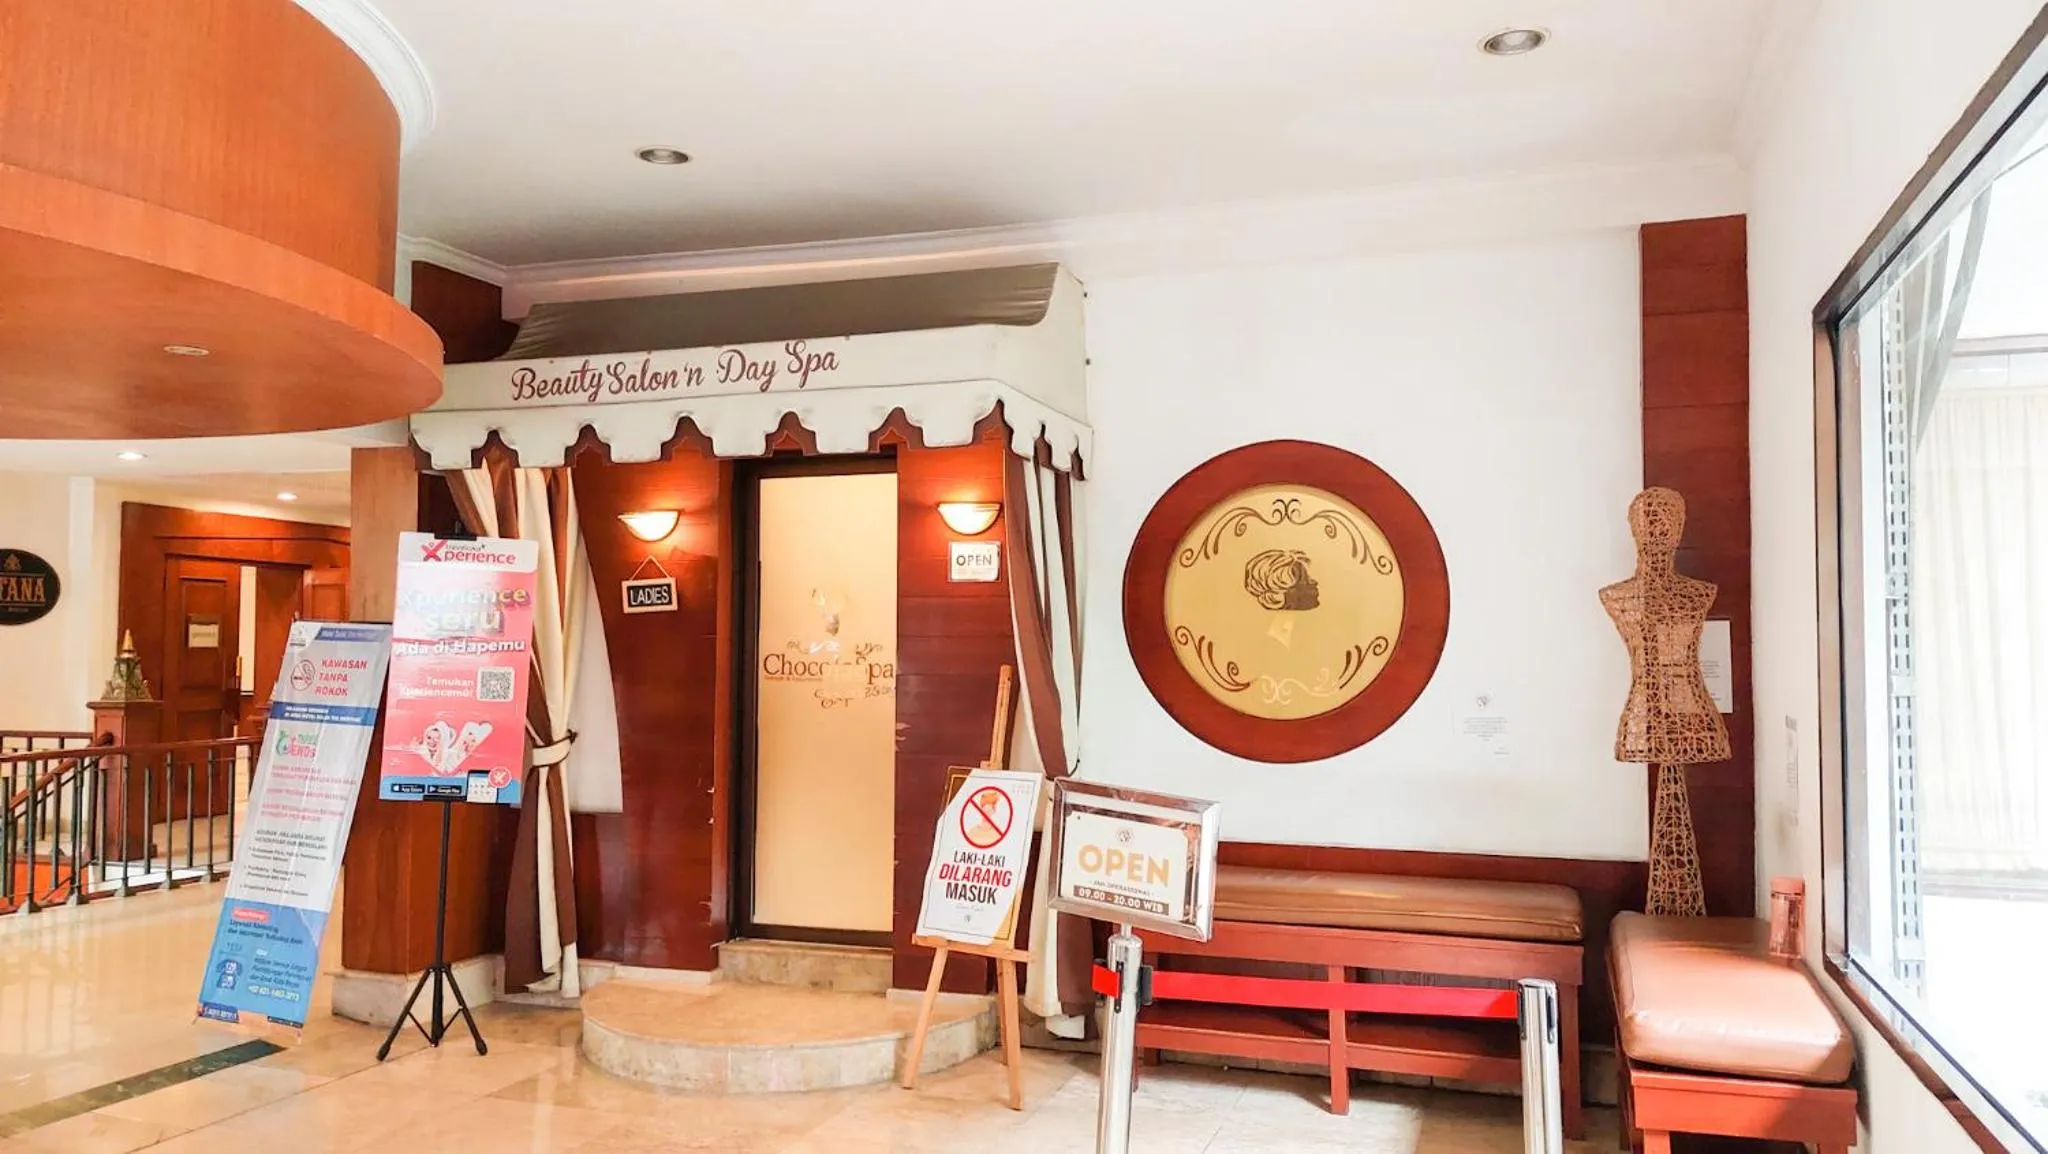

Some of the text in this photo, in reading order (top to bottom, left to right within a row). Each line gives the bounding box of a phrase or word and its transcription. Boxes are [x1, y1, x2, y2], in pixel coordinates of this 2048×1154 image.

[511, 359, 604, 402] Beauty
[606, 358, 679, 395] Salon
[716, 349, 779, 393] Day
[785, 339, 839, 388] Spa
[956, 554, 992, 567] OPEN
[630, 586, 670, 606] LADIES
[394, 641, 428, 656] Ada
[321, 659, 368, 669] KAWASAN
[319, 672, 348, 682] TANPA
[426, 676, 475, 687] Temukan
[314, 686, 348, 696] ROKOK
[953, 851, 1006, 868] LAKI-LAKI
[1078, 843, 1172, 888] OPEN
[938, 863, 1013, 888] DILARANG
[945, 881, 999, 905] MASUK
[1079, 887, 1105, 901] 09.00
[1143, 900, 1164, 913] WIB
